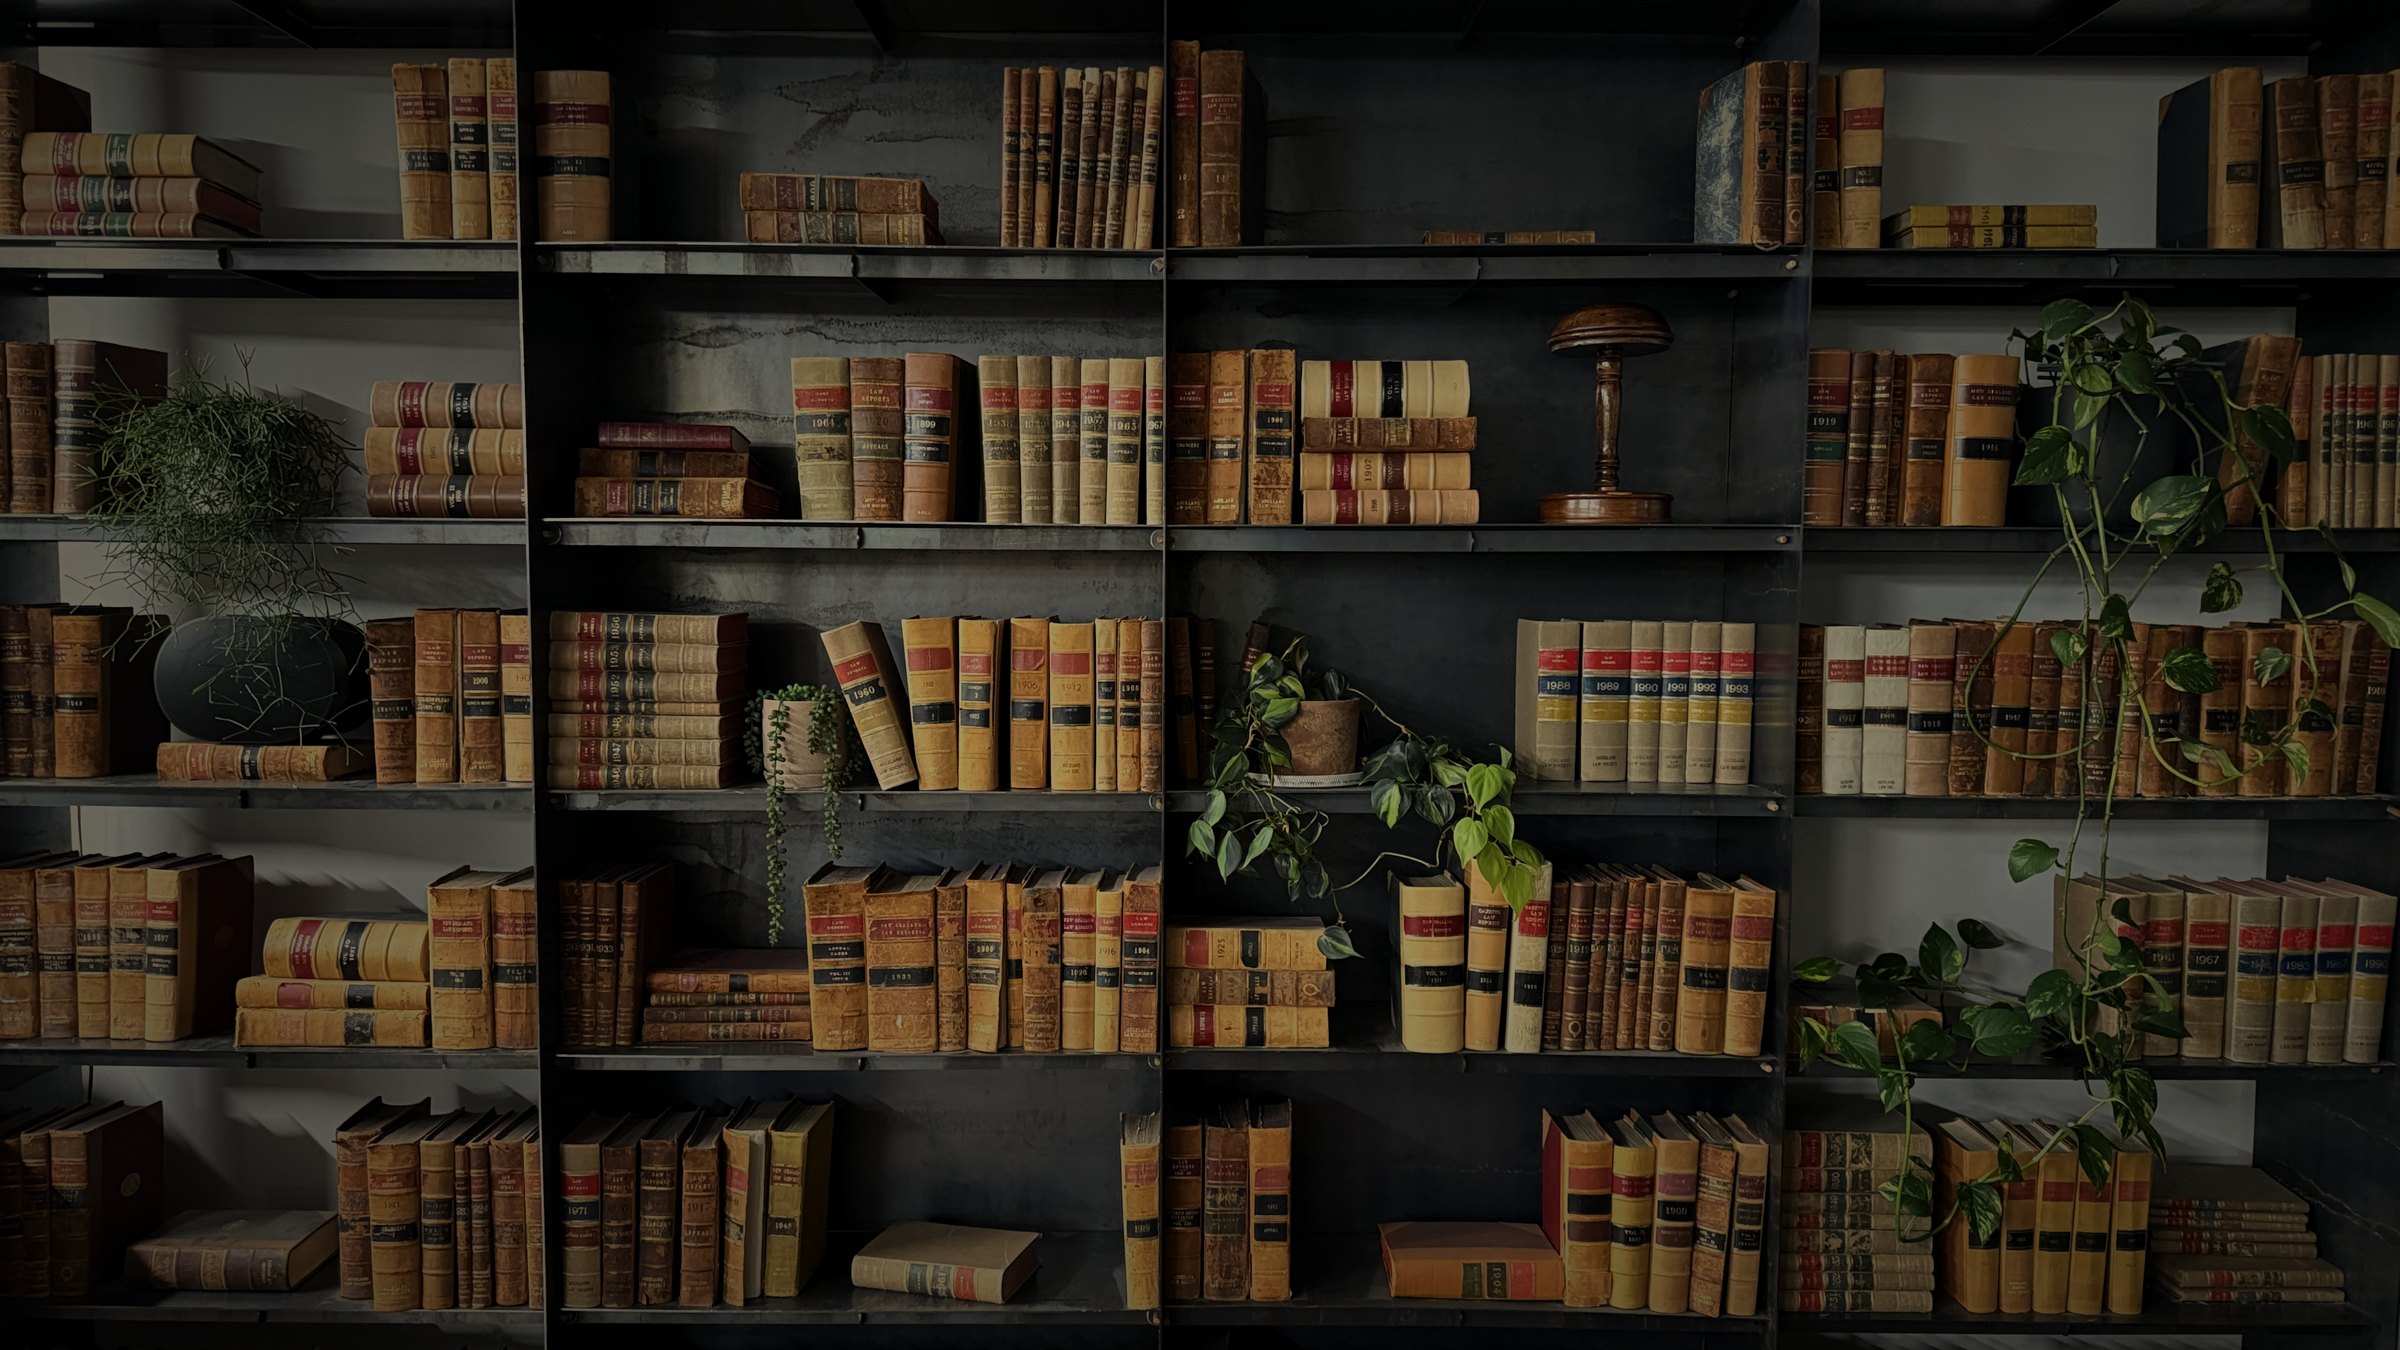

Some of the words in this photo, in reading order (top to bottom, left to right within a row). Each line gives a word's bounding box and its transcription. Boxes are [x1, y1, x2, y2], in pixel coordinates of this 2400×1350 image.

[1812, 417, 1836, 427] 1919
[1364, 458, 1372, 482] 1907
[1546, 681, 1570, 691] 1988
[1596, 681, 1620, 692] 1989
[1634, 682, 1658, 692] 1990
[1667, 683, 1687, 692] 1991
[1693, 683, 1717, 692] 1992
[1726, 684, 1749, 693] 1993
[852, 686, 876, 700] 1960
[1218, 938, 1226, 958] 1925
[2196, 954, 2220, 966] 1967
[2286, 961, 2310, 972] 1983
[568, 1206, 588, 1215] 1971
[1665, 1206, 1688, 1216] 1900
